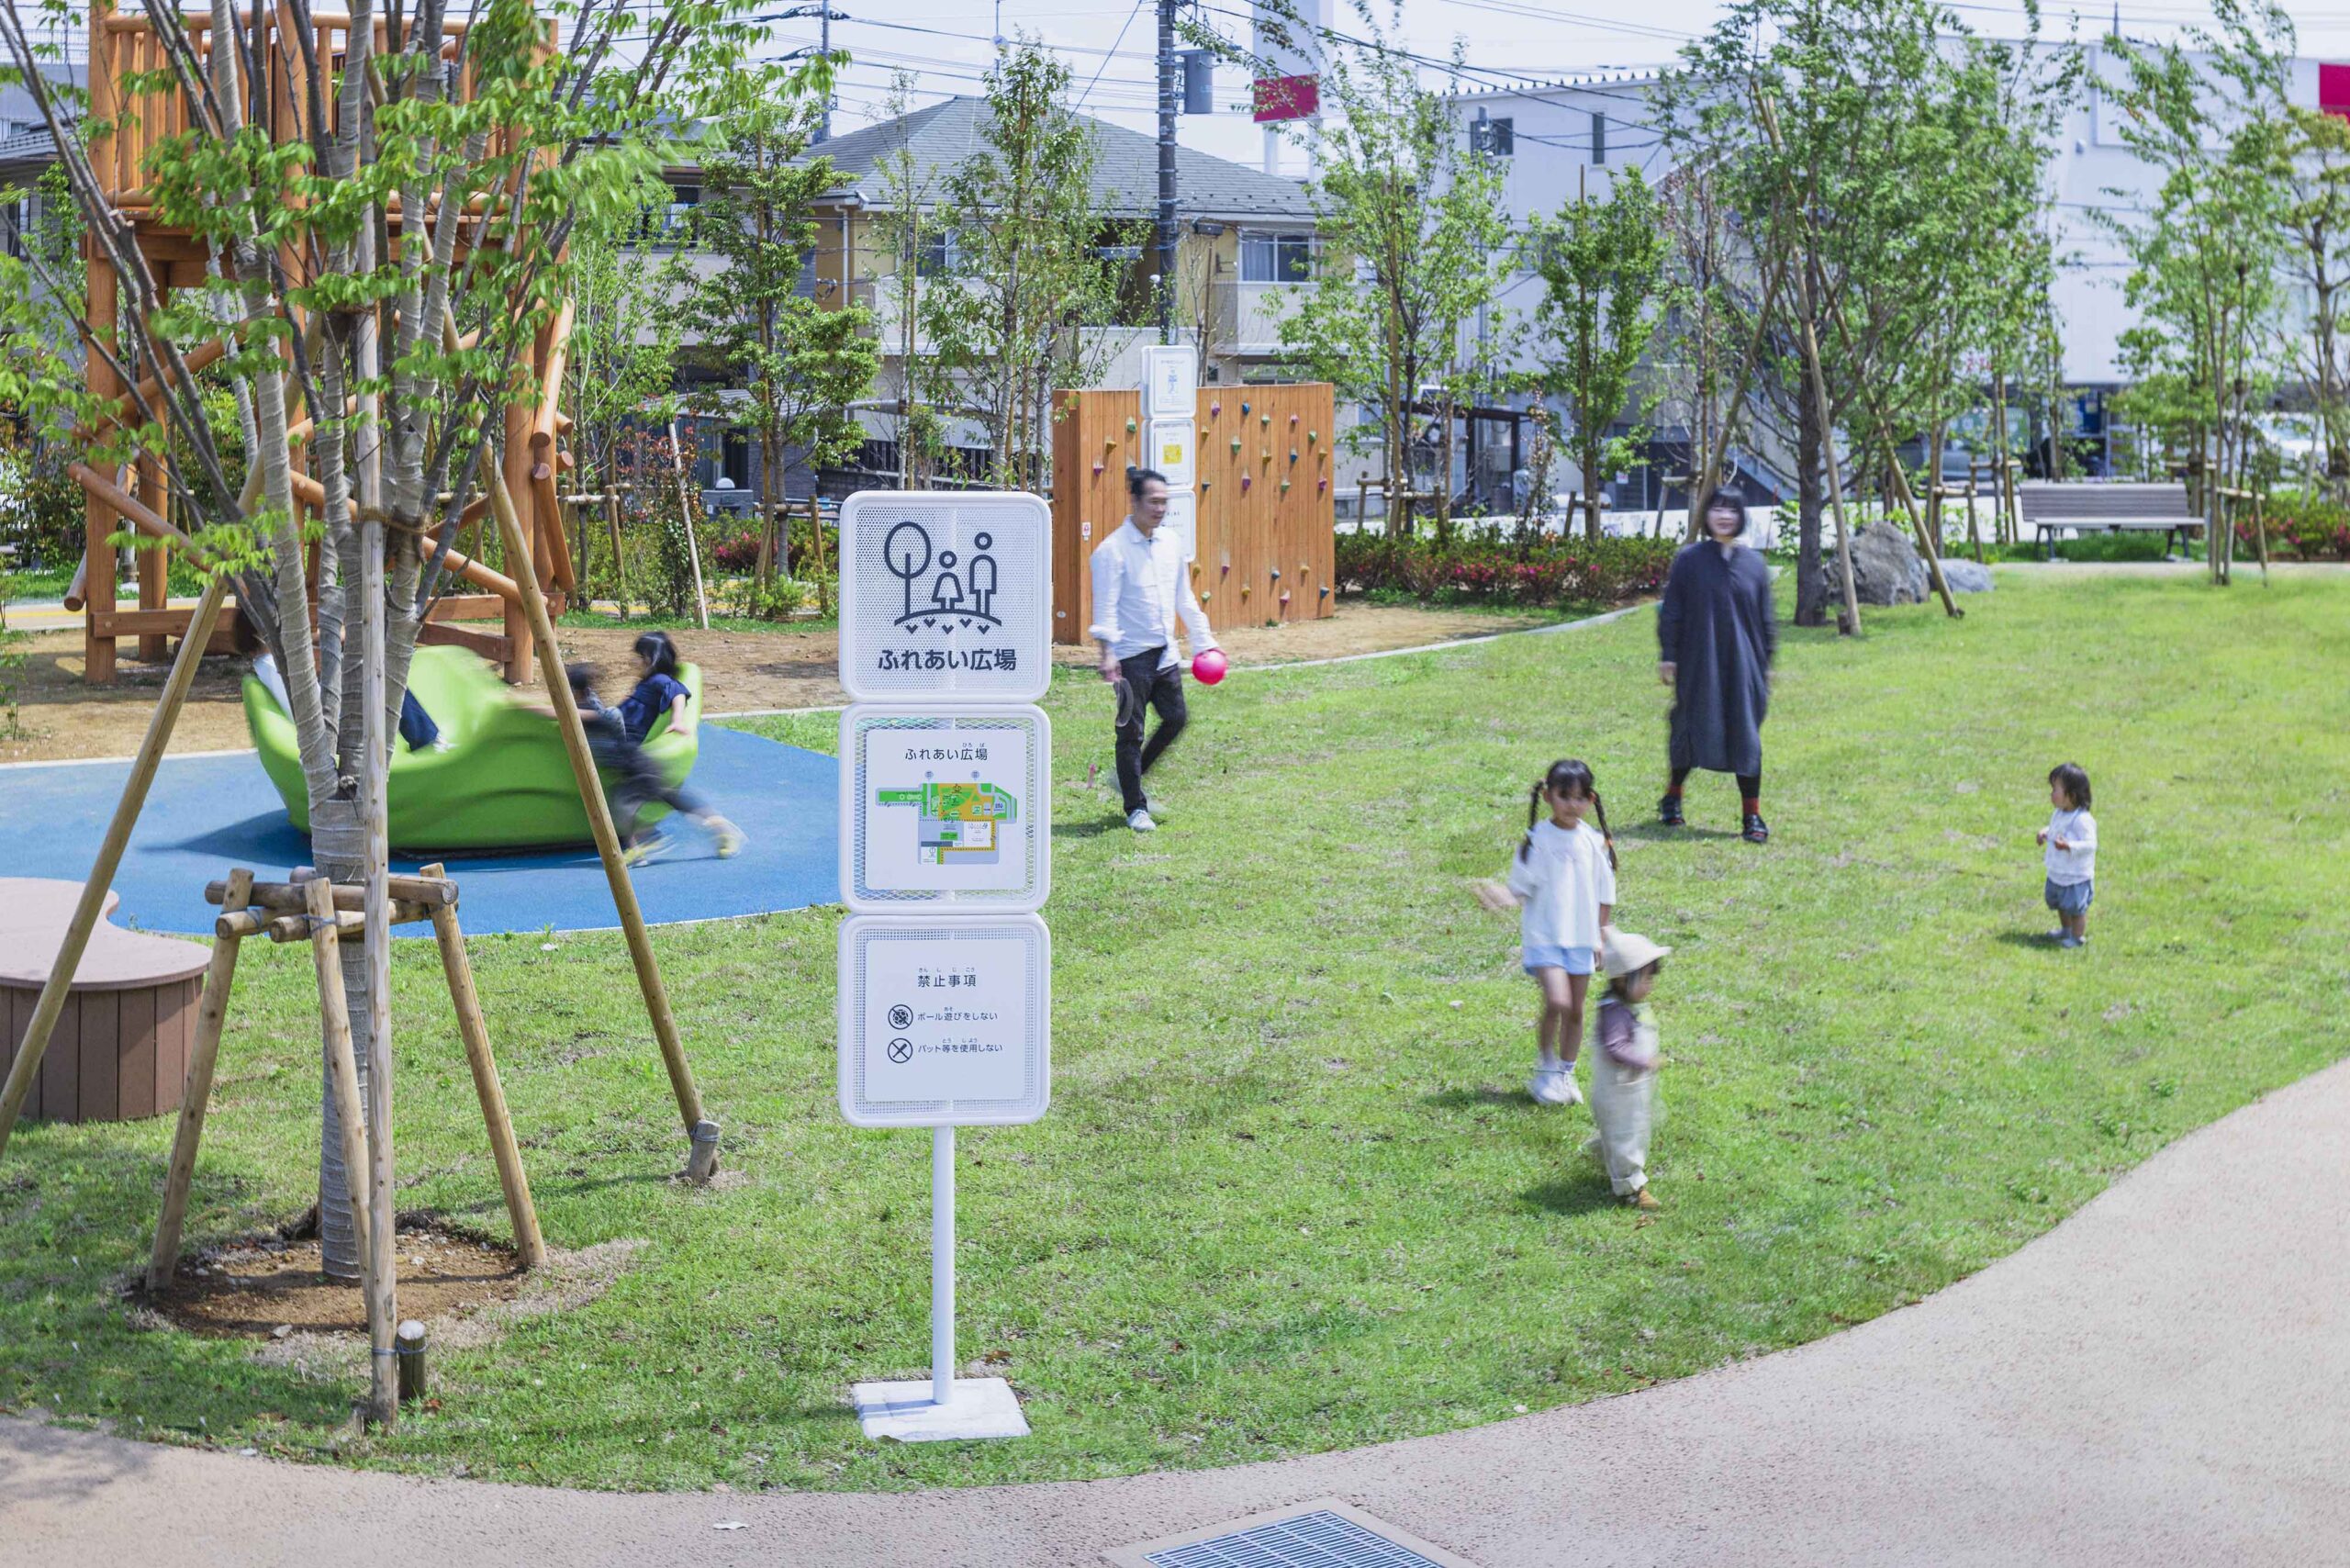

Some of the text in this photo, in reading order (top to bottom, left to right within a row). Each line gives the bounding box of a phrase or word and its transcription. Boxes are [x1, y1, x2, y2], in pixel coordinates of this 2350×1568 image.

[878, 648, 1017, 671] ふれあい広場
[905, 748, 988, 761] ふれあい広場
[918, 974, 977, 988] 禁止事項
[917, 1012, 998, 1021] ボール遊びをしない
[918, 1044, 1003, 1053] バット等を使用しない
